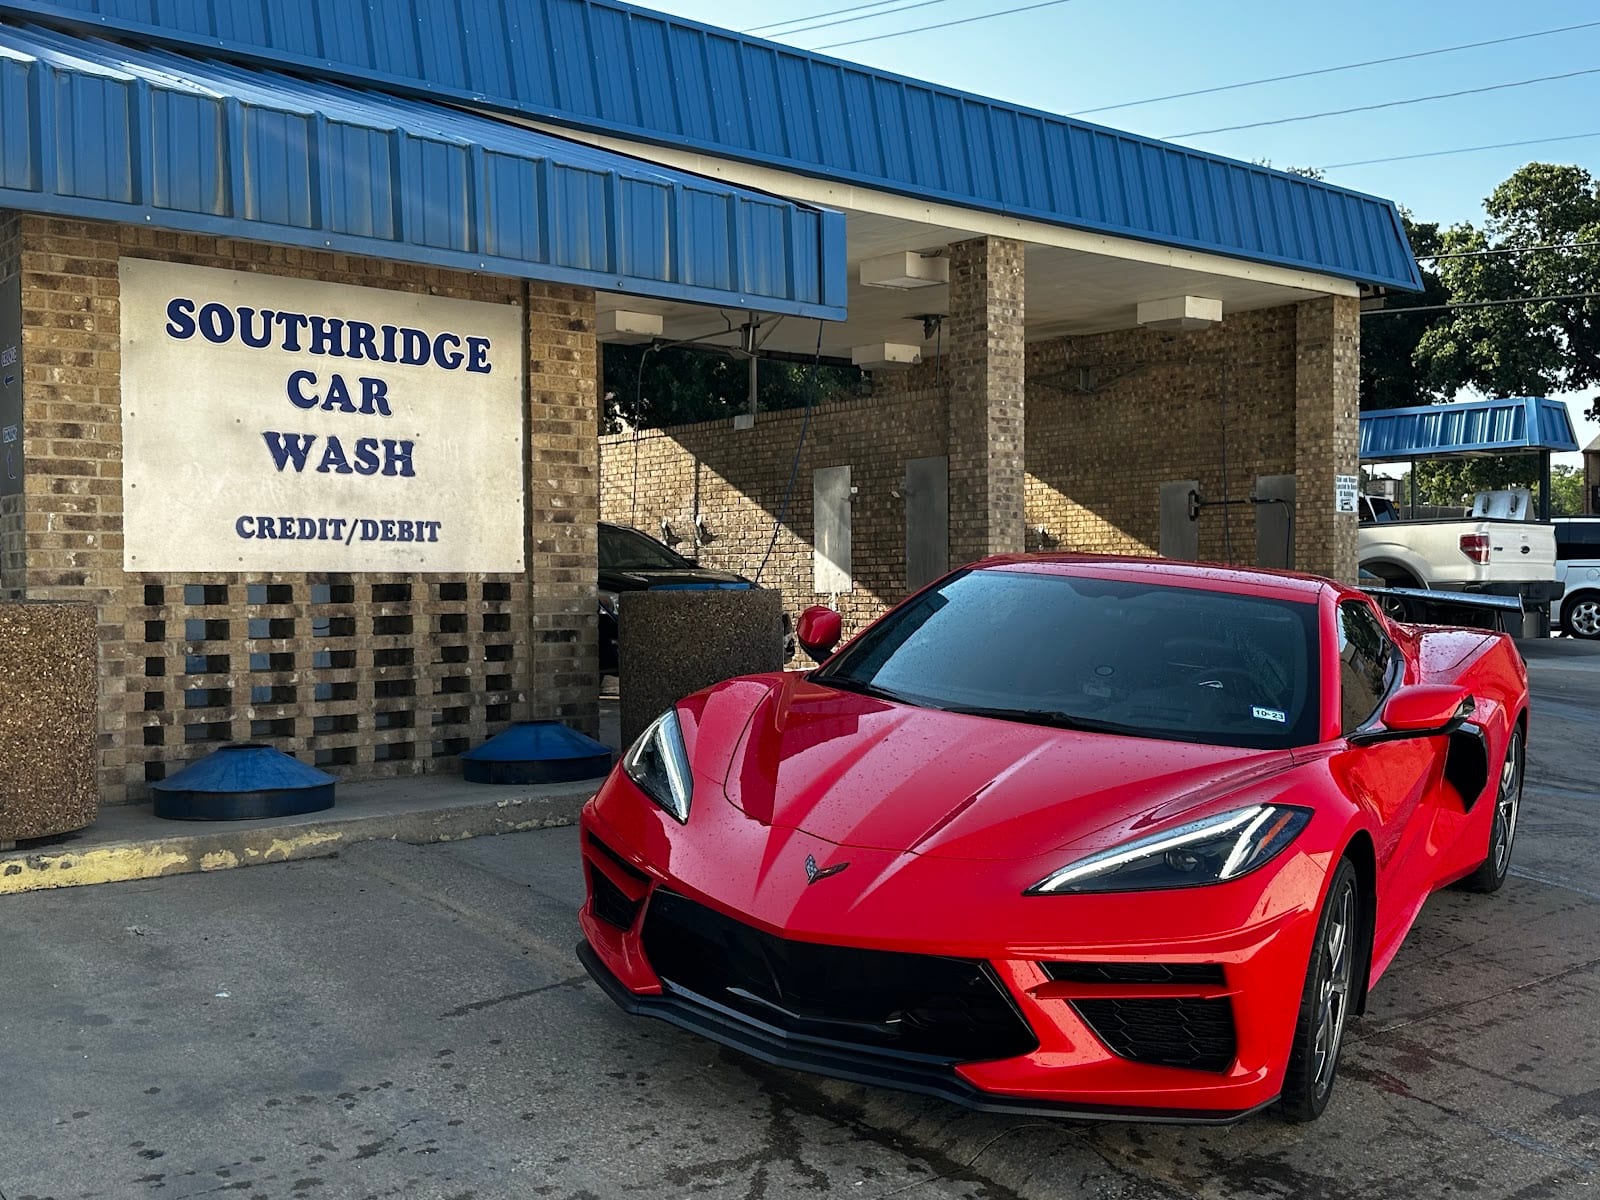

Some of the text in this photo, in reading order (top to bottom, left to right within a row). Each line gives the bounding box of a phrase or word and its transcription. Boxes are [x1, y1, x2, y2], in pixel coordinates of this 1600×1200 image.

[166, 298, 492, 374] SOUTHRIDGE
[286, 370, 392, 416] CAR
[263, 431, 416, 477] WASH
[235, 515, 442, 546] CREDIT/DEBIT
[1255, 710, 1284, 720] 10-23
